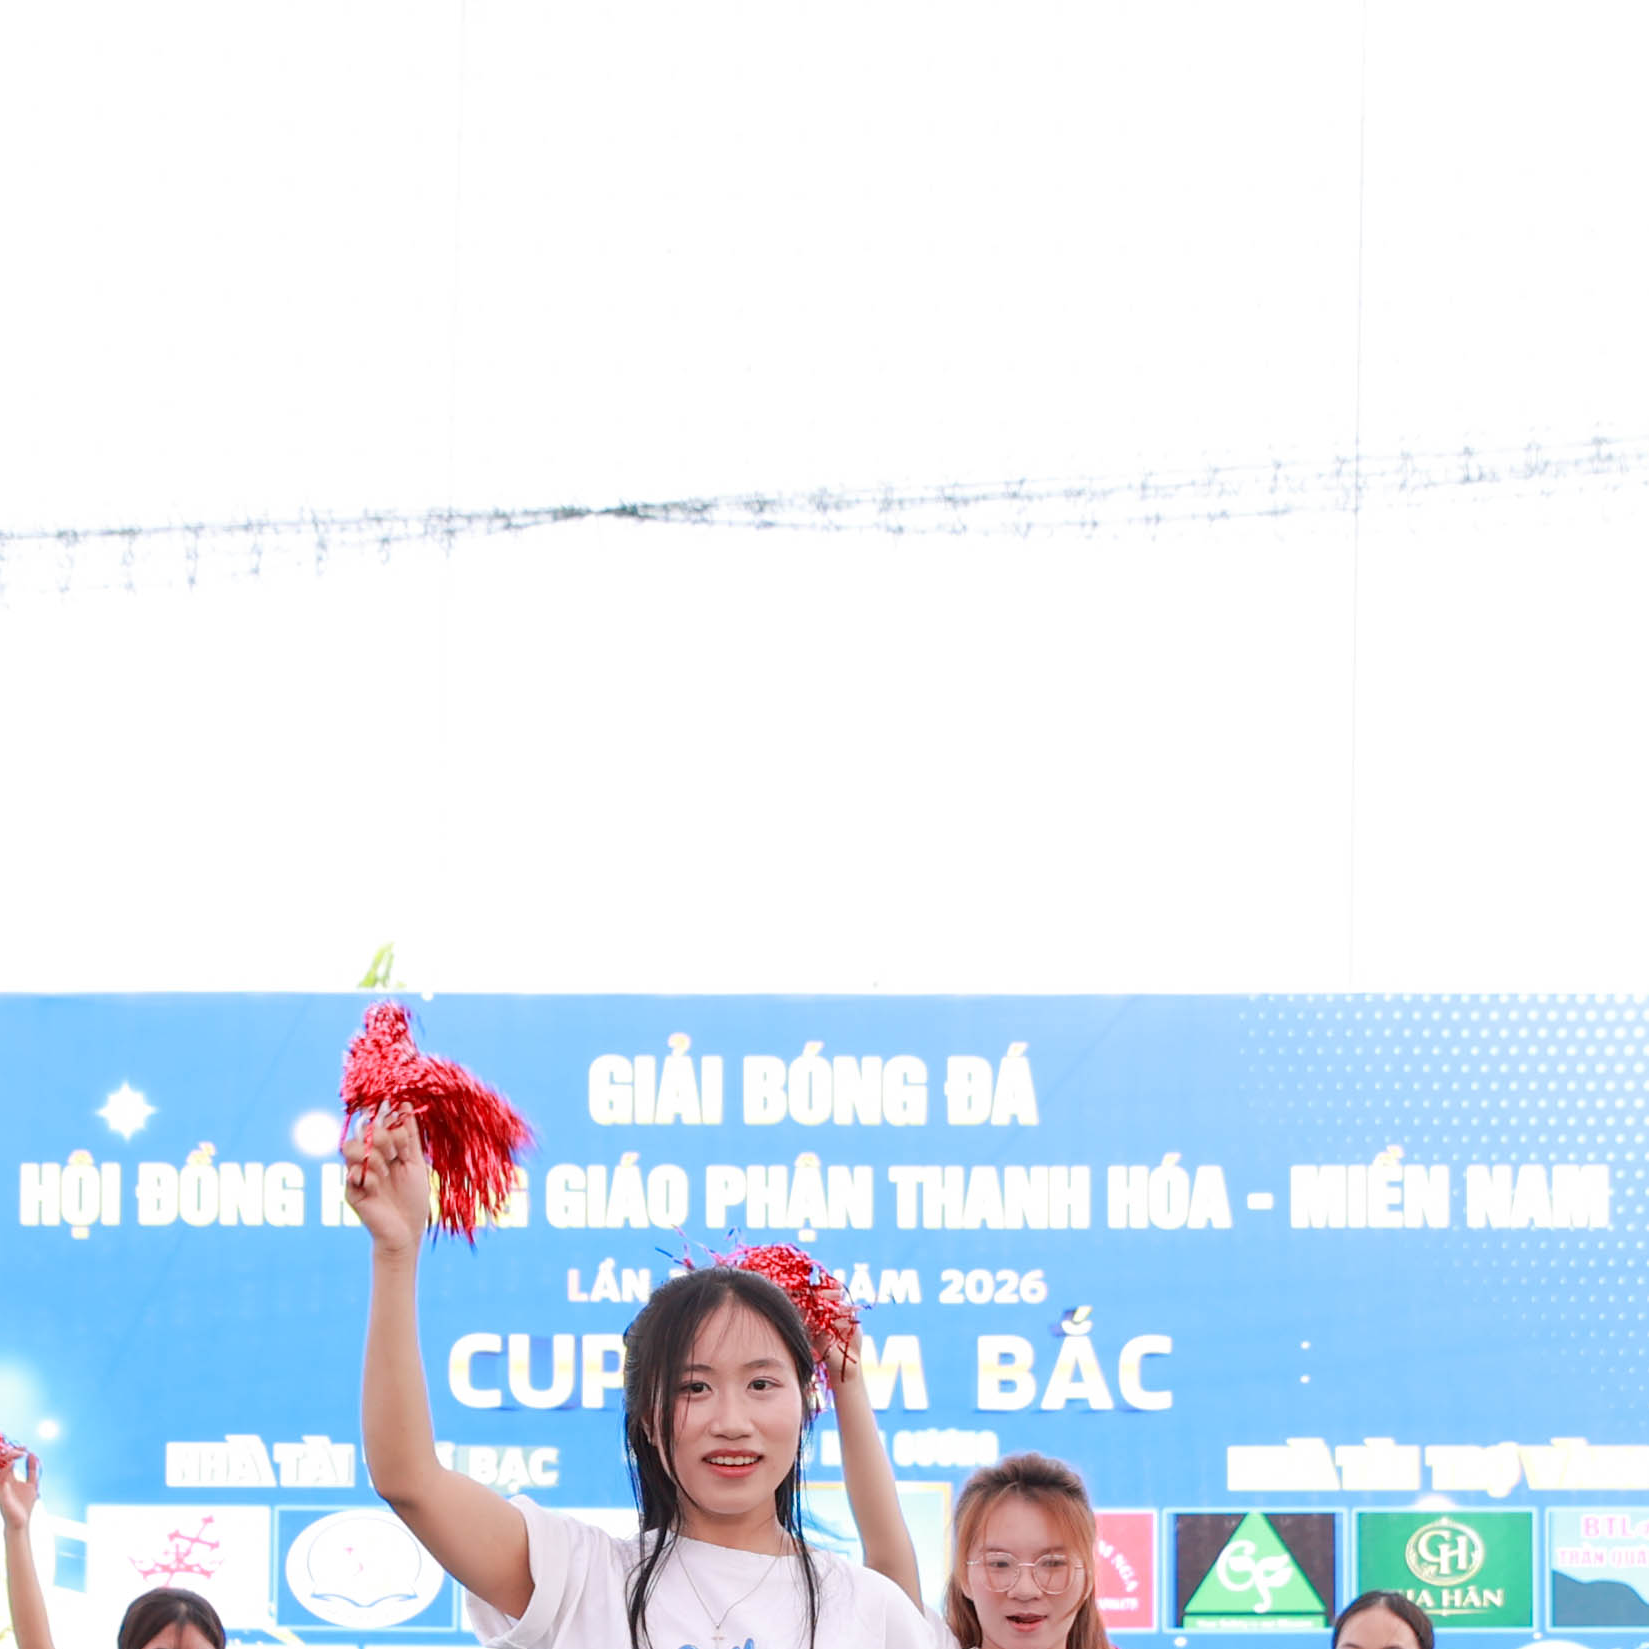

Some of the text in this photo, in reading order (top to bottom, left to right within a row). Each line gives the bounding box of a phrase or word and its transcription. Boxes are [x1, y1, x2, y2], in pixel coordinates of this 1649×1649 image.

[589, 1034, 1039, 1126] GIẢI BÓNG ĐÁ
[20, 1150, 120, 1239] HỘI
[137, 1142, 303, 1227] ĐỒNG
[547, 1153, 688, 1229] GIÁO
[706, 1154, 873, 1242] PHẬN
[889, 1164, 1089, 1229] THANH
[1108, 1154, 1231, 1229] HÓA
[1290, 1147, 1449, 1228] MIỀN
[1466, 1164, 1610, 1228] NAM
[850, 1267, 922, 1304] ĂM
[940, 1268, 1048, 1304] 2026
[449, 1333, 626, 1410] CUP
[978, 1306, 1174, 1412] BẮC
[470, 1446, 560, 1493] BẠC
[1582, 1515, 1633, 1538] BTL
[1400, 1588, 1434, 1607] IA
